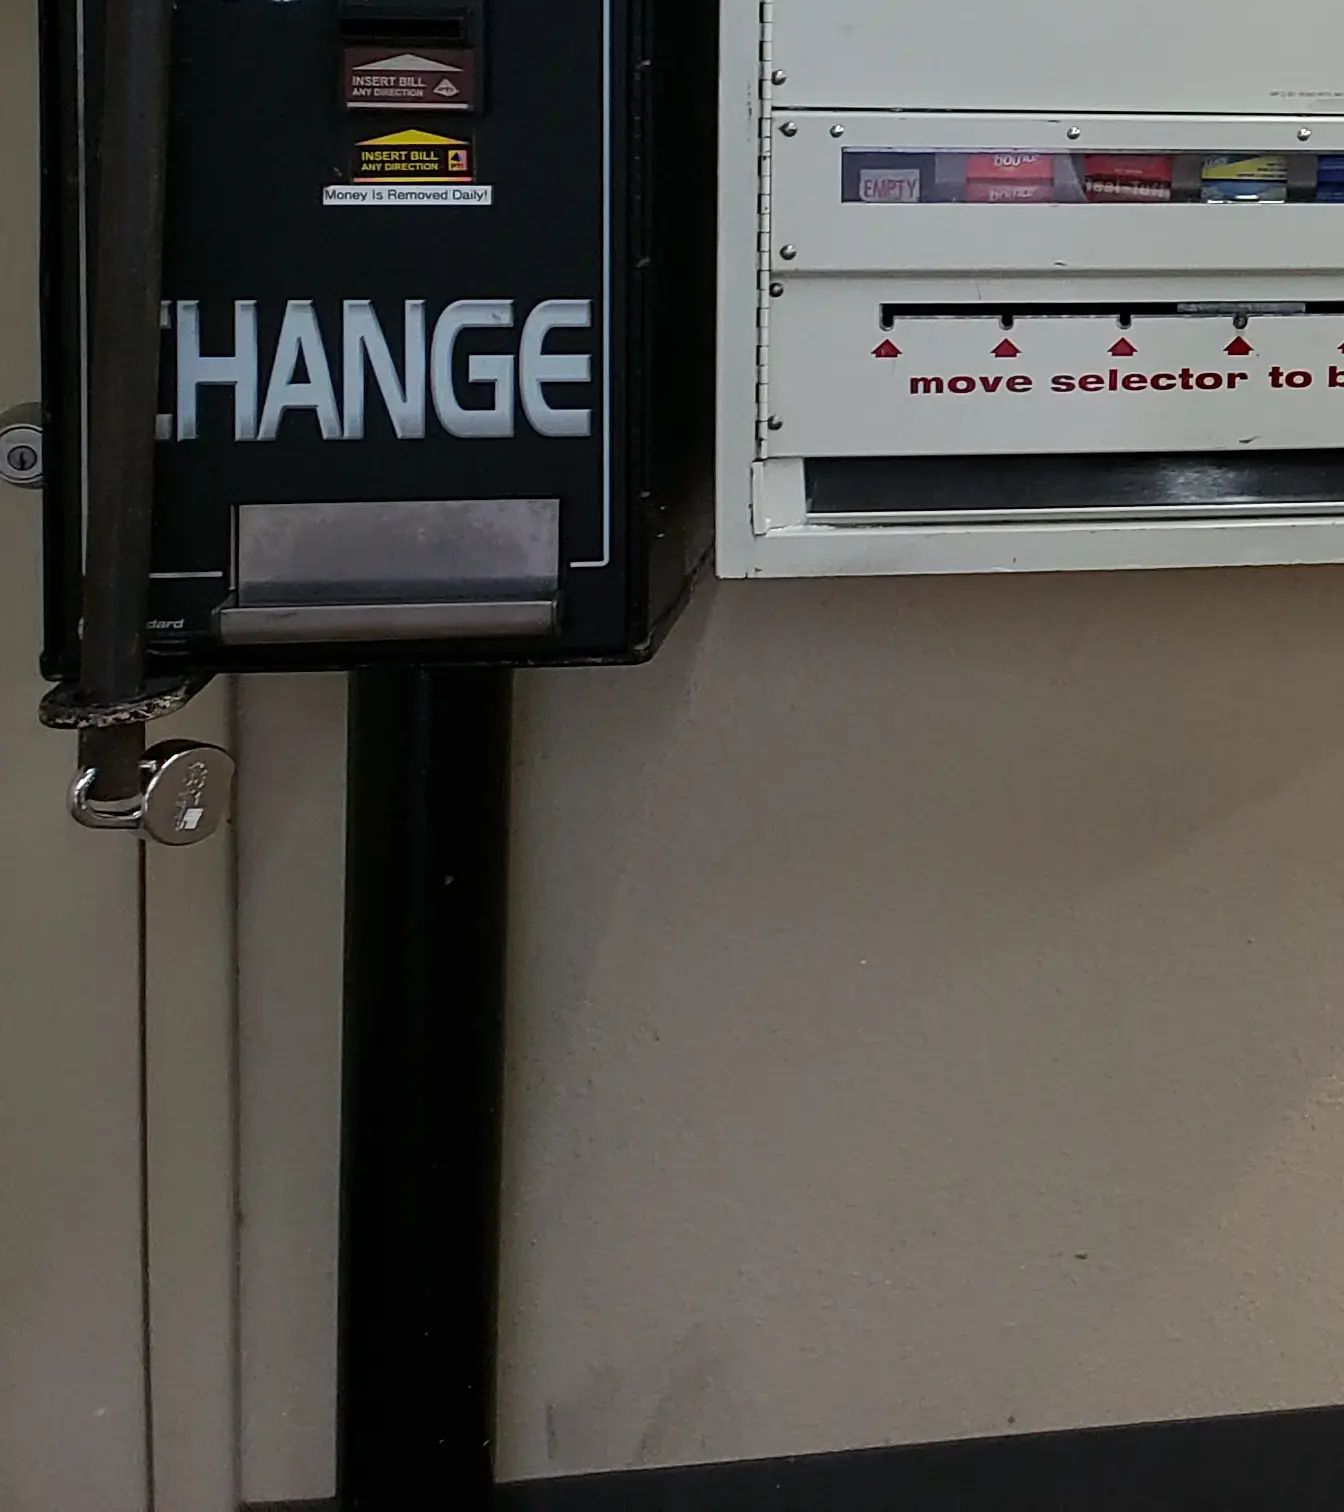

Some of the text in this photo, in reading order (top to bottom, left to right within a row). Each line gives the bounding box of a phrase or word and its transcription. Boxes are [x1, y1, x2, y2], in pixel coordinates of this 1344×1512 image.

[352, 75, 396, 87] INSERT
[398, 76, 427, 88] BILL
[352, 87, 424, 97] ANY DIRECTION
[361, 150, 439, 161] INSERT BILL
[361, 162, 381, 172] ANY
[384, 162, 439, 171] DIRECTION
[864, 179, 917, 198] EMPTY
[325, 189, 488, 203] Money Is Removed Daily!
[153, 299, 595, 443] HANGE
[909, 374, 1033, 394] move
[1050, 368, 1249, 393] selector
[1268, 366, 1313, 388] to
[146, 618, 185, 630] dard
